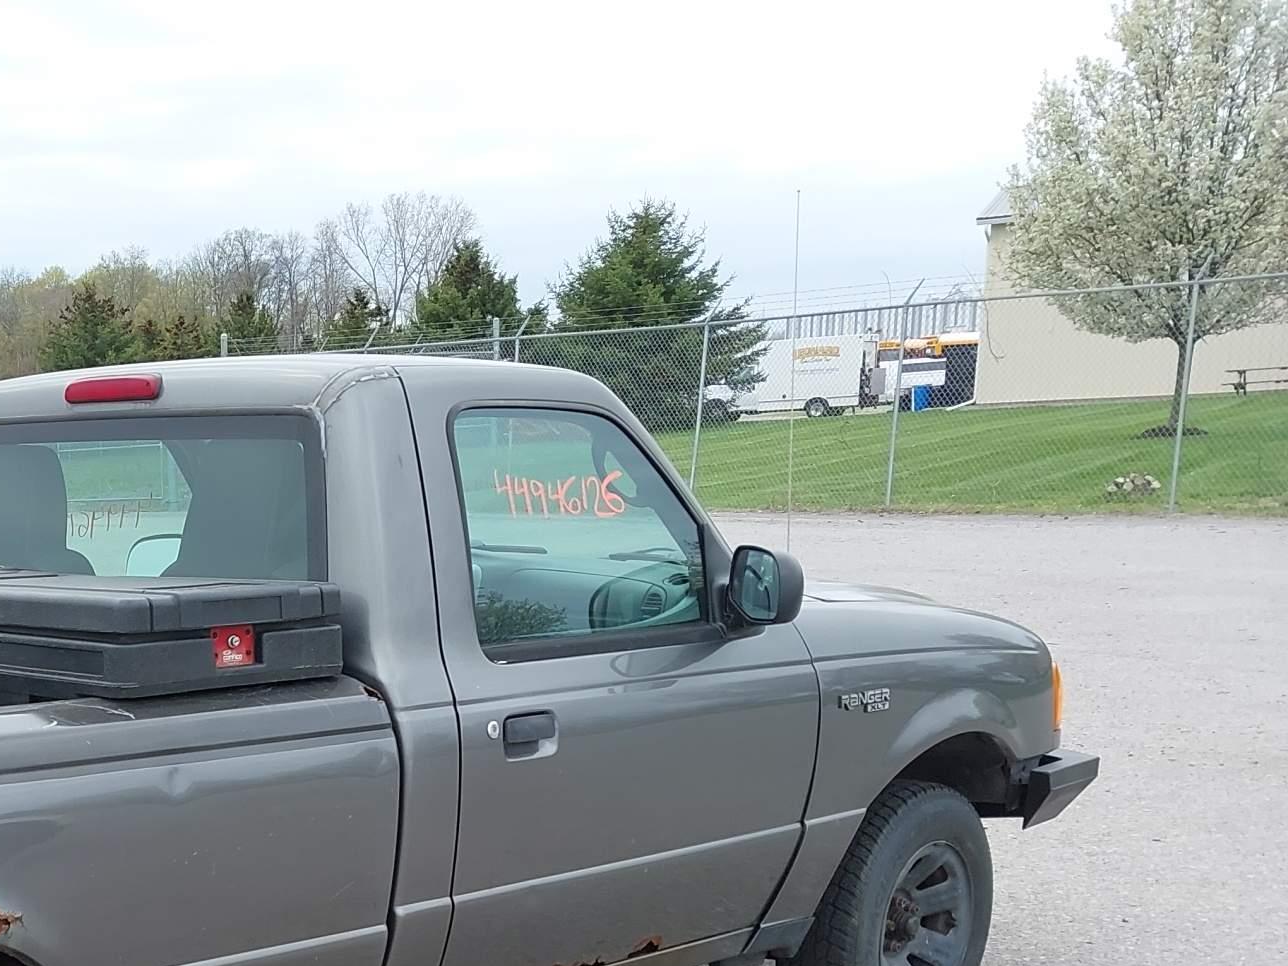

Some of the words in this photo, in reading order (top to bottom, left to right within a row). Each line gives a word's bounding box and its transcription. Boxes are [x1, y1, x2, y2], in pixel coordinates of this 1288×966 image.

[494, 469, 625, 519] 44946126
[838, 688, 890, 711] RANGER
[870, 702, 890, 713] XLT
